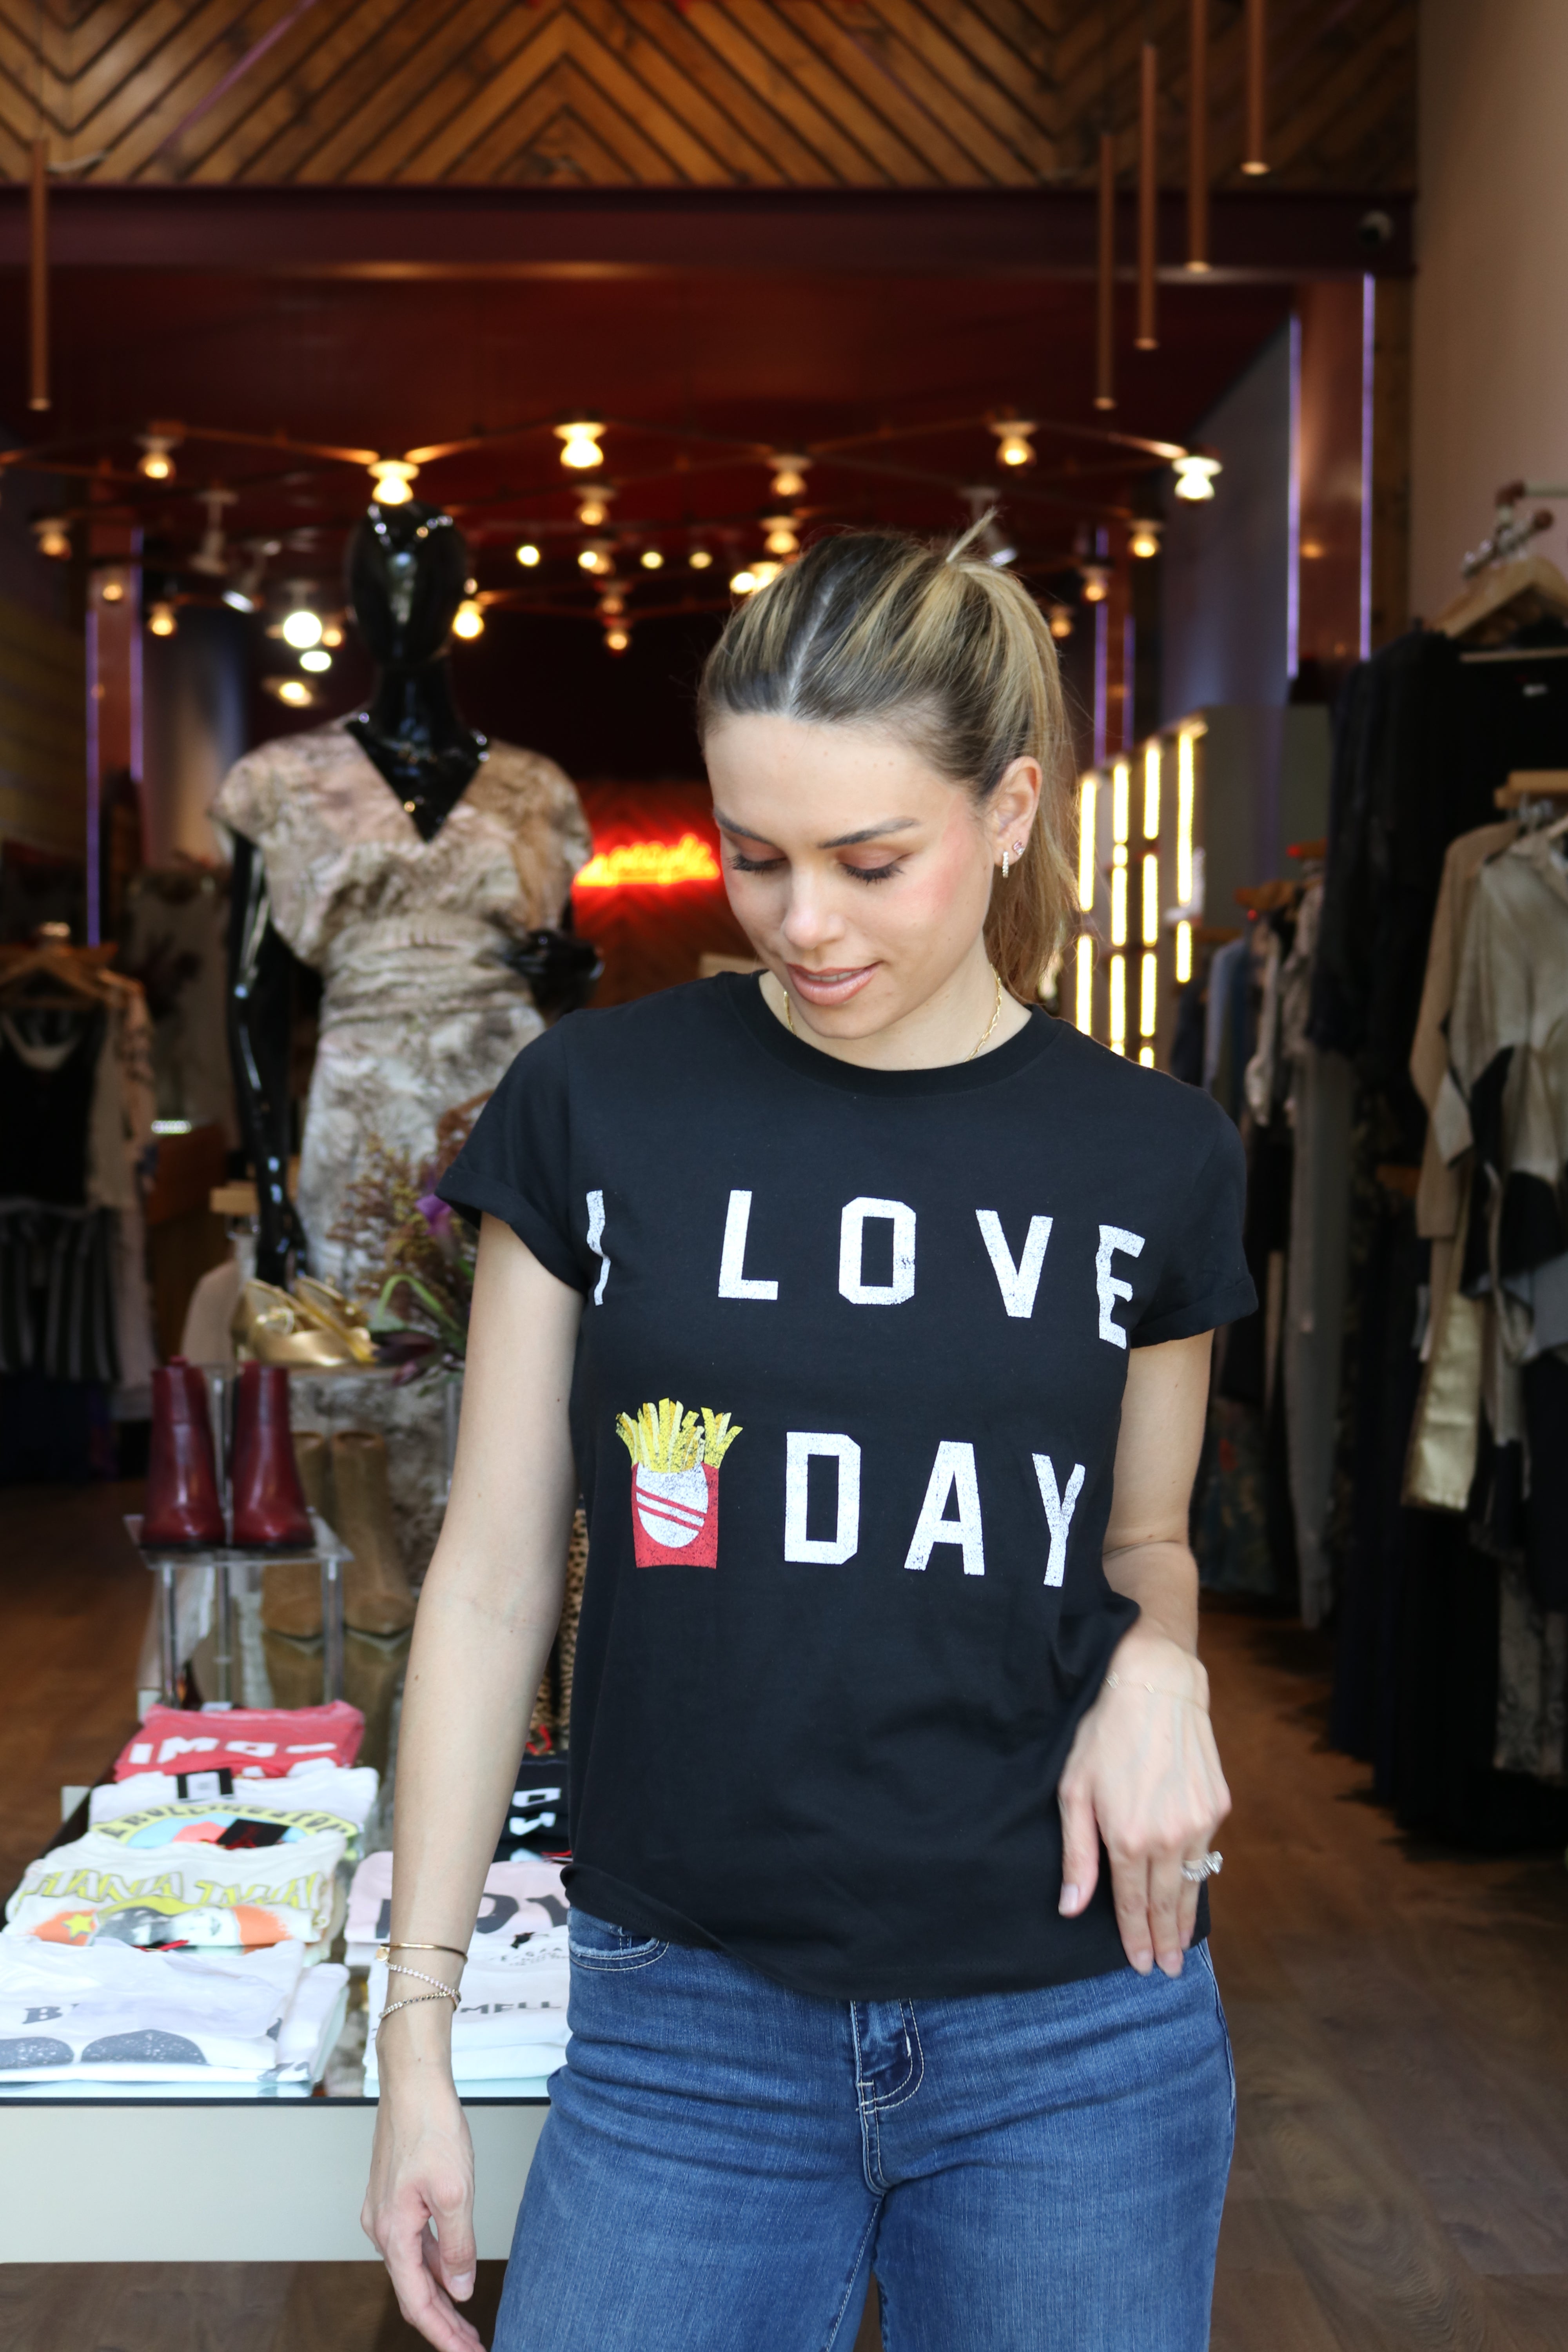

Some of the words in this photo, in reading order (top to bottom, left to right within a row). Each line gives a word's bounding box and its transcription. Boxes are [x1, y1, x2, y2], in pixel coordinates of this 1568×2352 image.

[586, 1189, 611, 1306] I
[718, 1189, 1145, 1350] LOVE
[784, 1432, 1085, 1587] DAY
